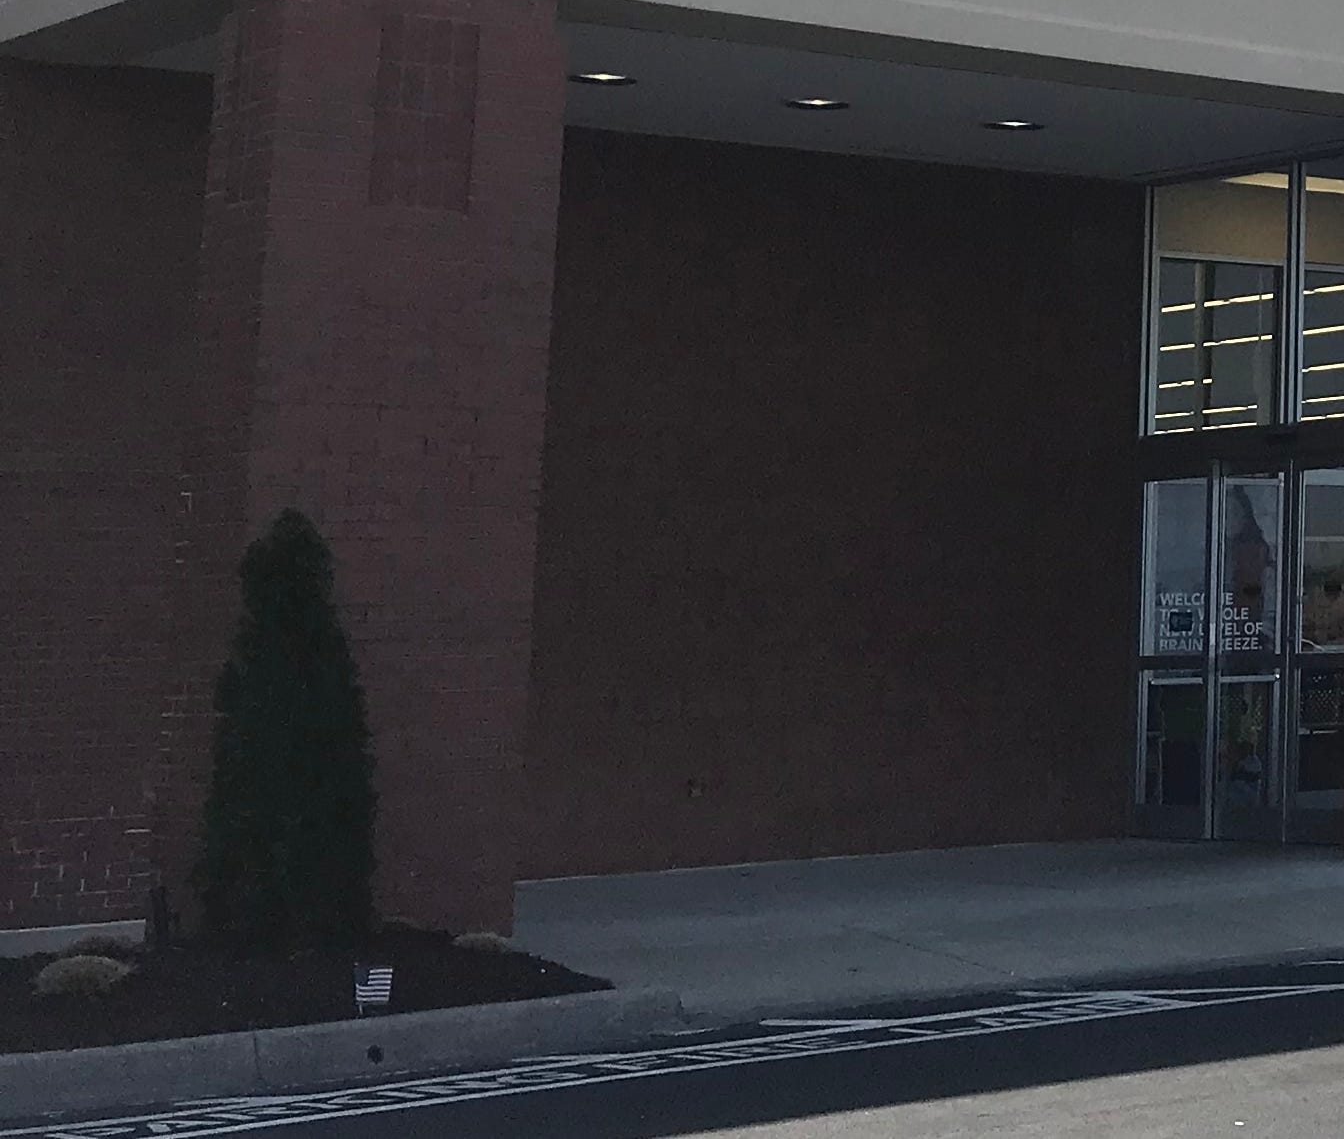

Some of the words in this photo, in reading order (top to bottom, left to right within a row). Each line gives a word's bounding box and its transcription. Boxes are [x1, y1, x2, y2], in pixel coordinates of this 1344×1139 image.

[1160, 592, 1234, 606] WELCE
[1243, 622, 1264, 635] OF
[1159, 638, 1204, 651] BRAIN
[1214, 637, 1263, 651] EEZE.
[592, 1037, 866, 1071] FIRE
